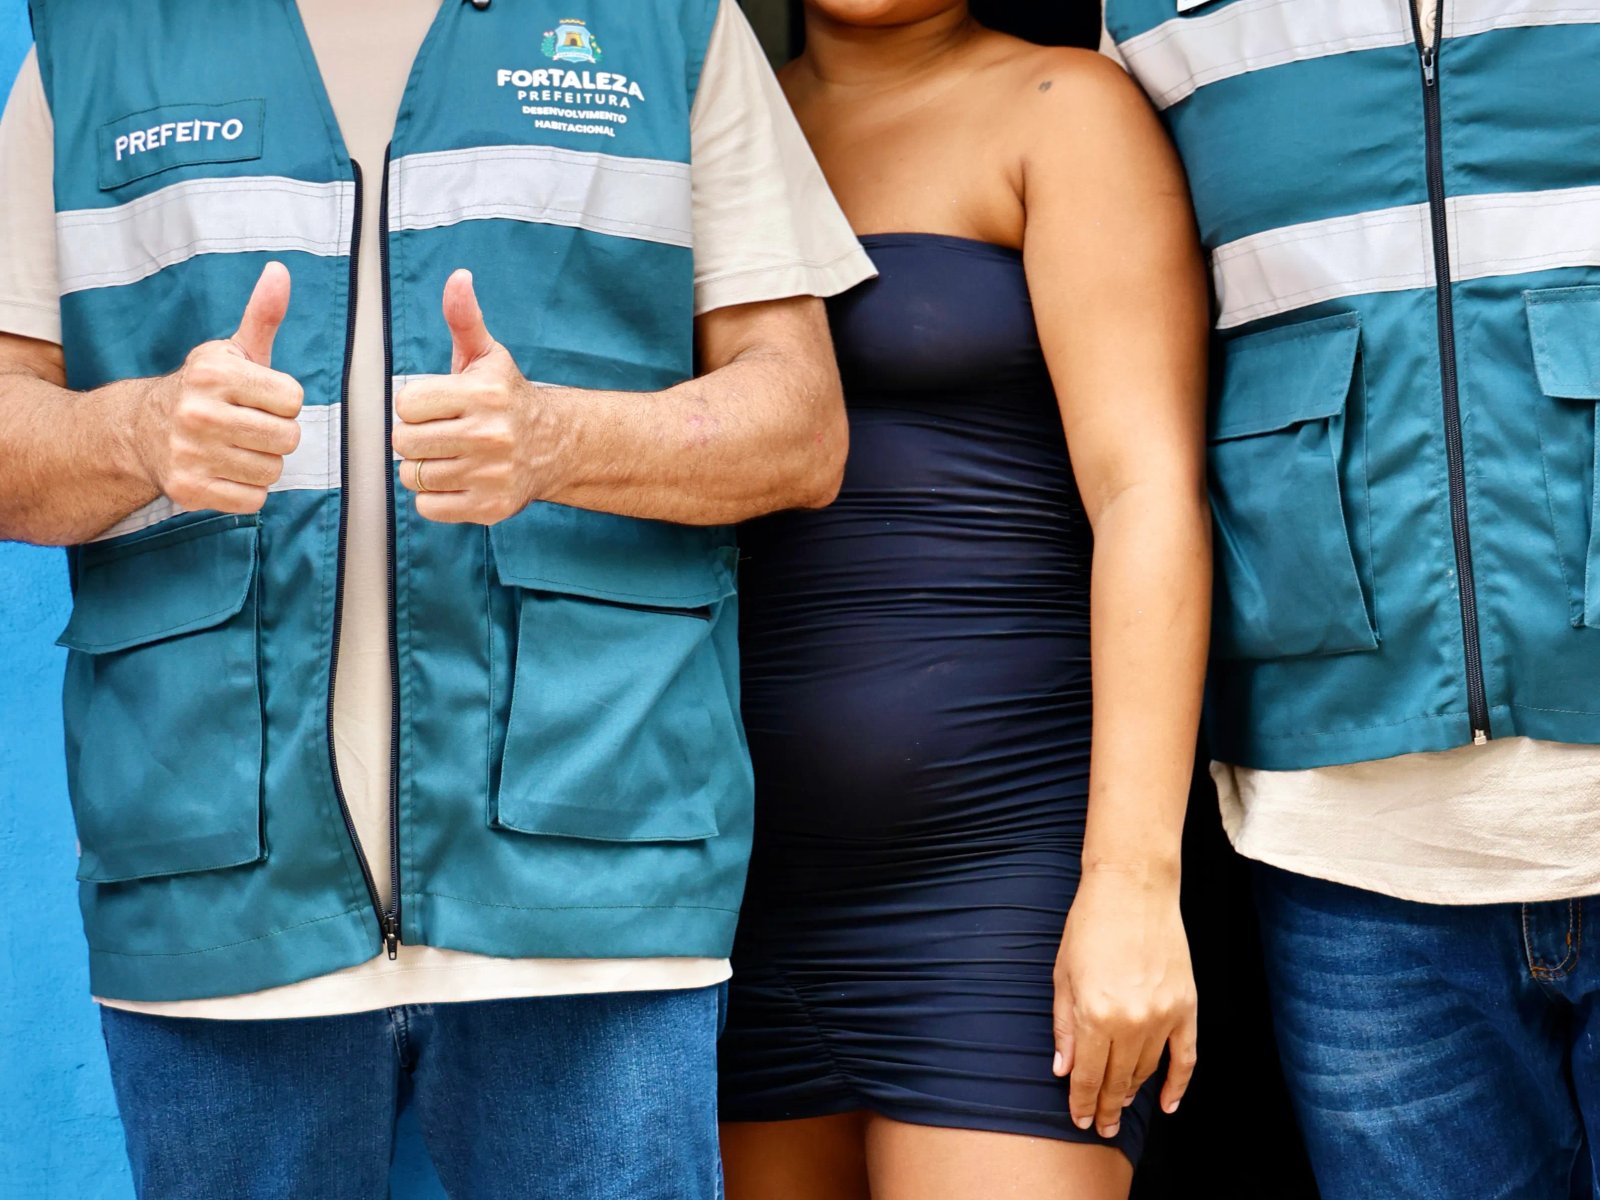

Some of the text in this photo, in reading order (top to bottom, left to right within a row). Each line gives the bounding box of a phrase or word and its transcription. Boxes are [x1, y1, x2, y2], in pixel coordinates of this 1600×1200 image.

[497, 68, 645, 101] FORTALEZA
[517, 90, 631, 108] PREFEITURA
[522, 105, 627, 124] DESENVOLVIMENTO
[534, 120, 616, 137] HABITACIONAL
[115, 118, 243, 161] PREFEITO
